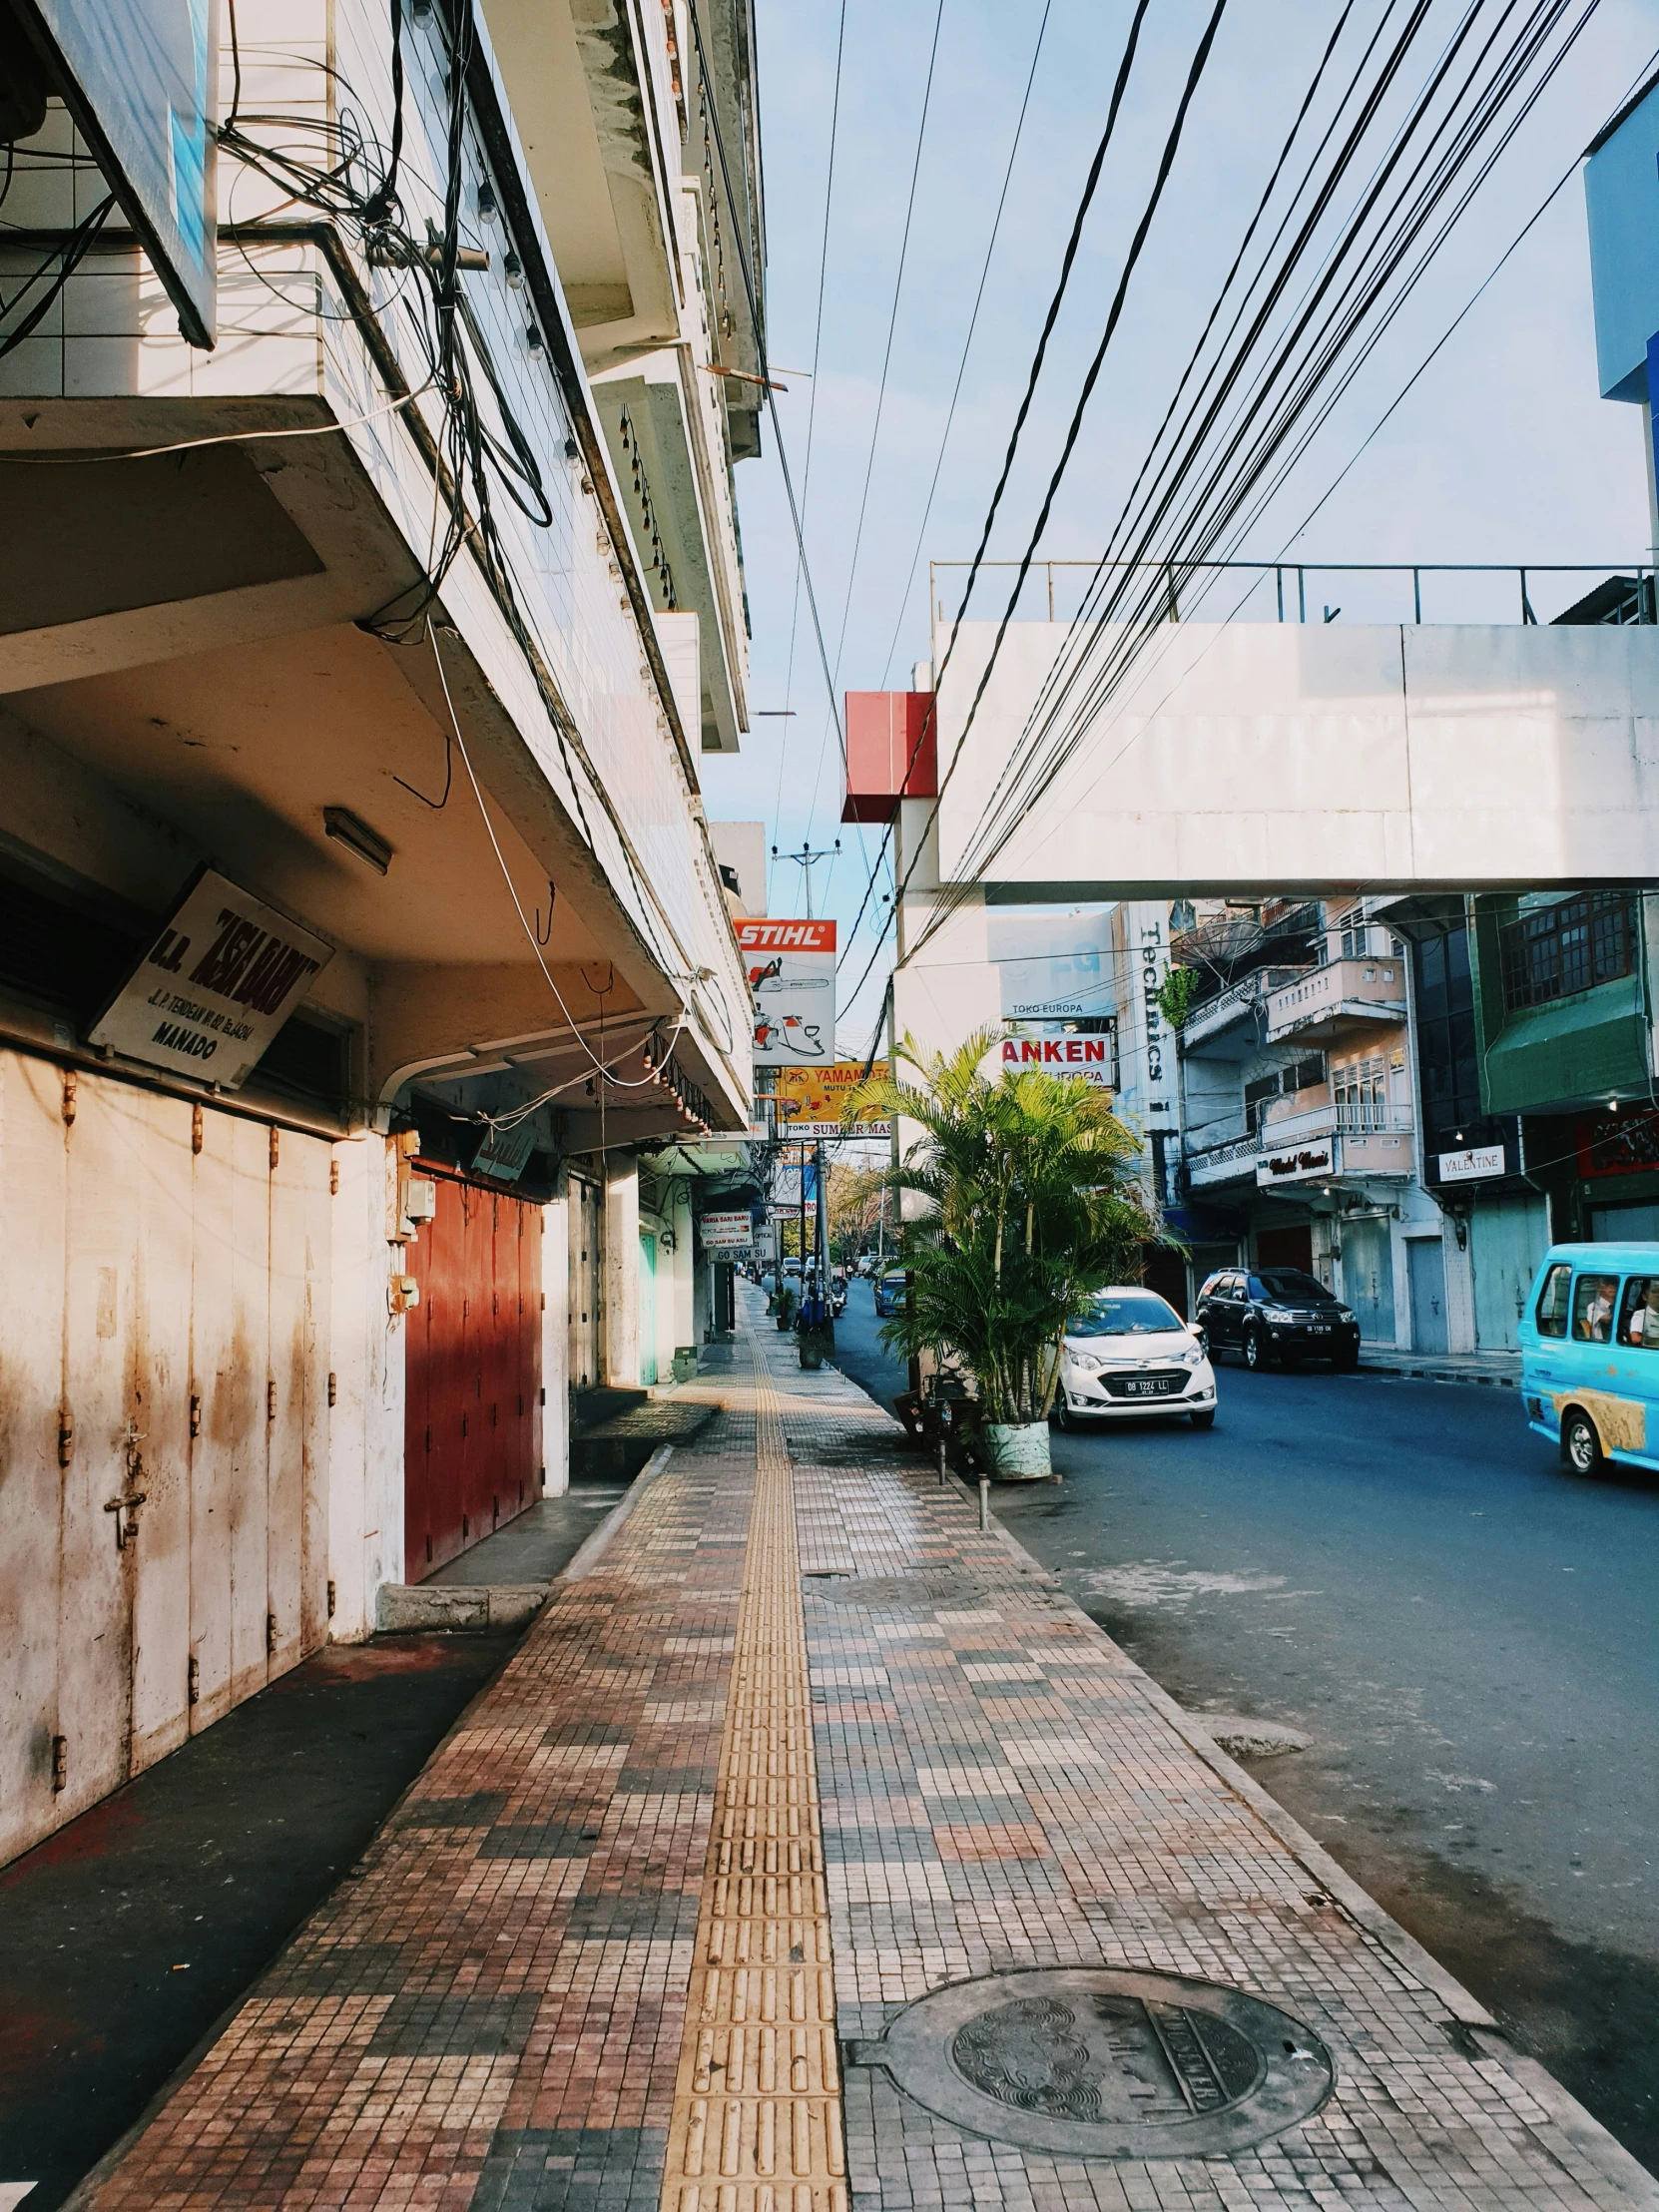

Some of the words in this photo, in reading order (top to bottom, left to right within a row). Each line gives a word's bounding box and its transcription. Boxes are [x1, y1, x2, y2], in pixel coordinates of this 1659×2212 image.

[1012, 1004, 1039, 1013] TOKO
[1042, 1004, 1083, 1013] EUROPA
[152, 1021, 219, 1060] MANADO
[813, 1123, 864, 1135] SUMR
[1445, 1155, 1498, 1172] VALENTINE
[718, 1251, 731, 1260] GO
[734, 1249, 752, 1260] SAM
[755, 1248, 767, 1259] SU
[1140, 1382, 1154, 1390] 1224
